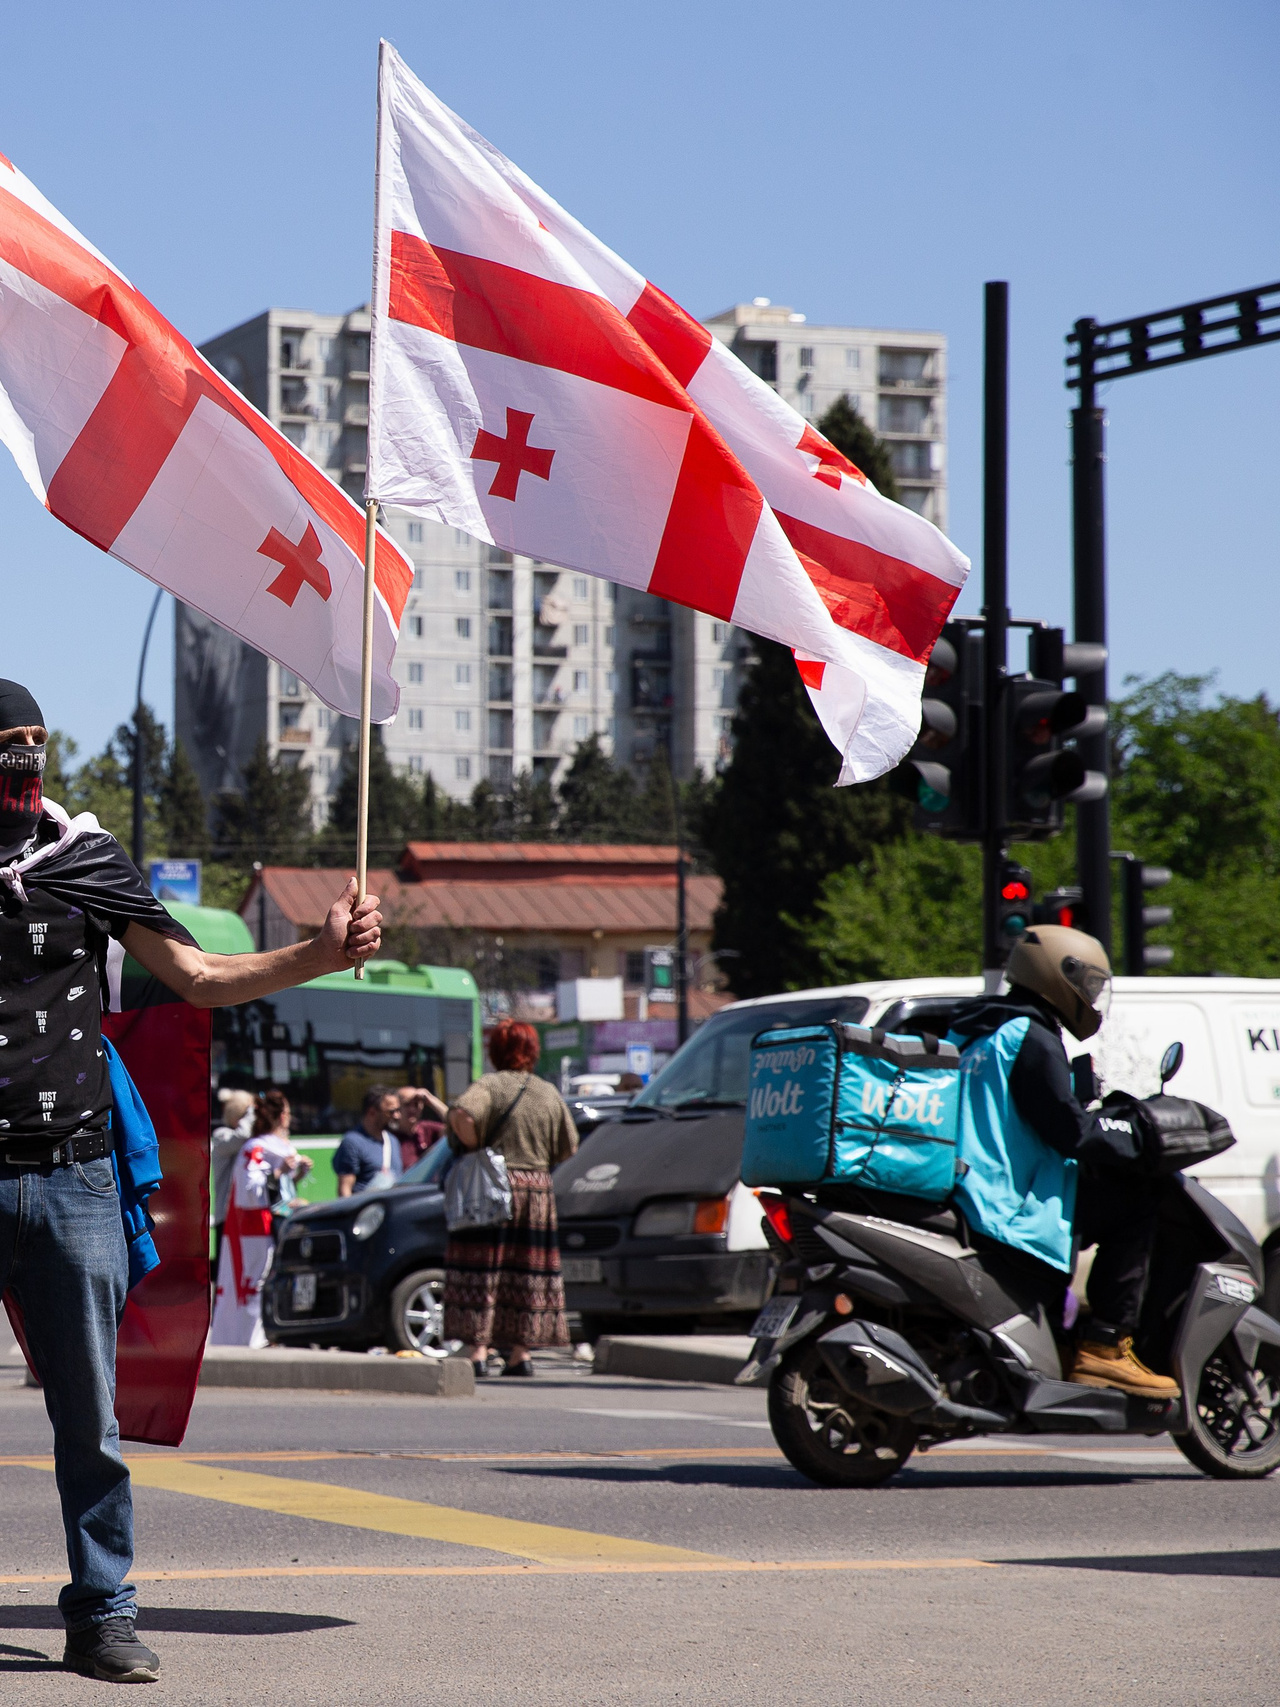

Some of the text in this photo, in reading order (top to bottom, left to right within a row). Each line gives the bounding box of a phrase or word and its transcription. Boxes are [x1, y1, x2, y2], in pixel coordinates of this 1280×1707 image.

[28, 923, 48, 934] JUST
[32, 934, 45, 944] DO
[33, 945, 43, 955] IT.
[37, 1018, 46, 1026] DO
[38, 1091, 57, 1102] JUST
[750, 1080, 805, 1120] Wolt
[42, 1102, 54, 1111] DO
[861, 1081, 945, 1126] Wolt
[42, 1112, 52, 1122] IT.
[1215, 1275, 1255, 1304] 125
